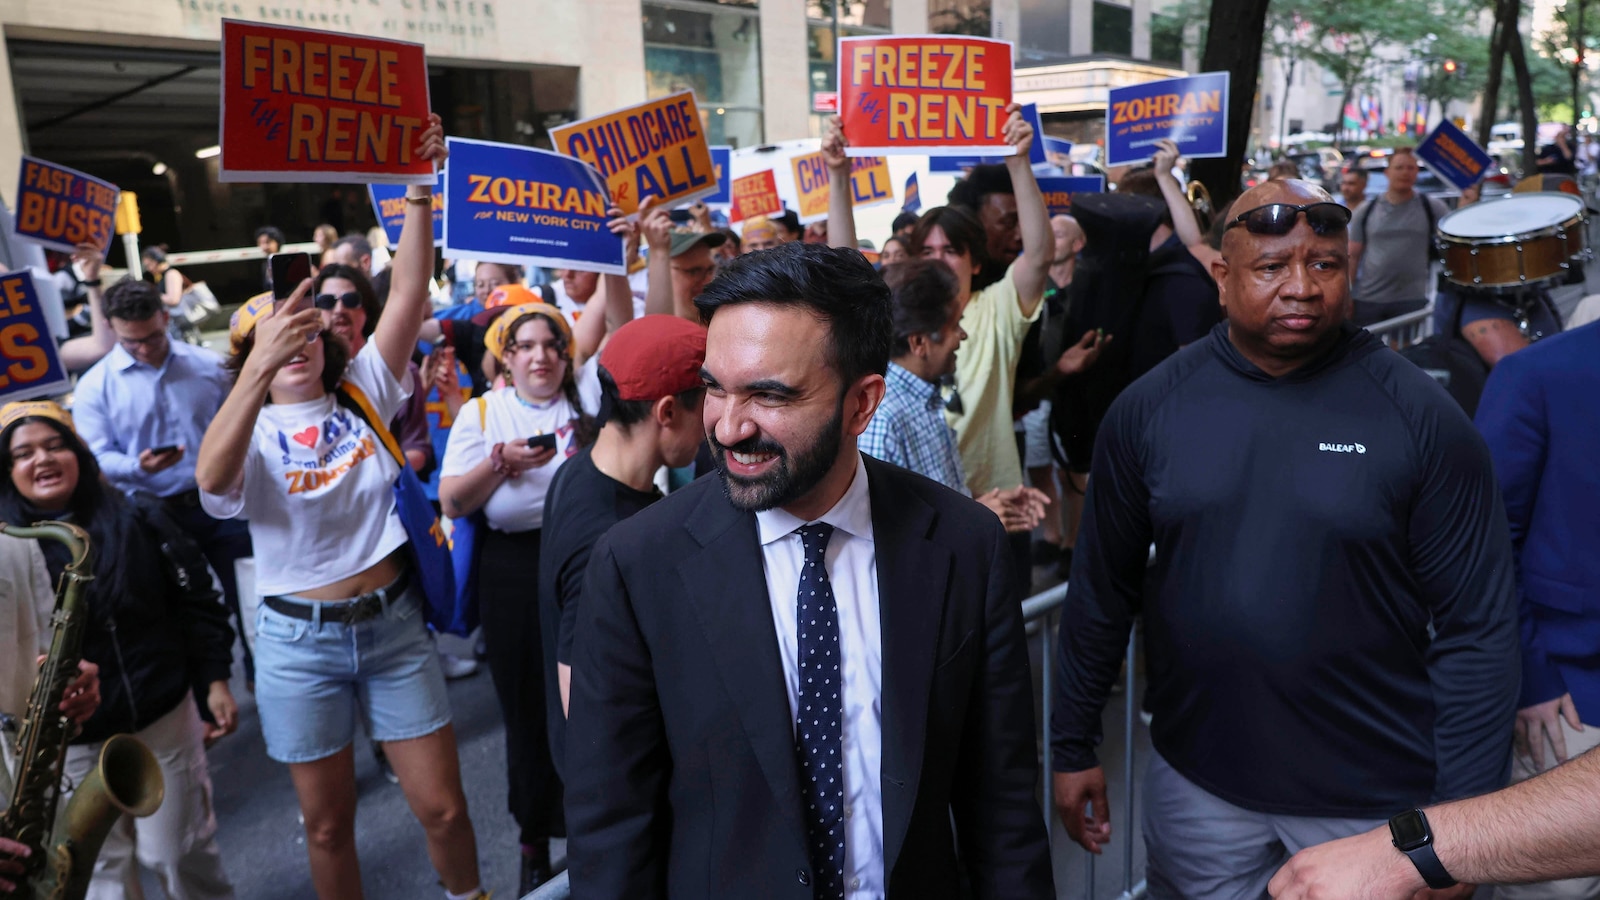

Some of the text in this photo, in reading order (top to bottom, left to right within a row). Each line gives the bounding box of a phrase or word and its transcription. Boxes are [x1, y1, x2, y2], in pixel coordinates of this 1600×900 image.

[242, 35, 402, 109] FREEZE
[852, 45, 986, 92] FREEZE
[250, 98, 285, 141] THE
[858, 92, 884, 124] THE
[888, 92, 1005, 140] RENT
[1112, 90, 1221, 125] ZOHRAN
[287, 102, 421, 165] RENT
[25, 162, 75, 197] FAST
[467, 174, 606, 218] ZOHRAN
[635, 146, 708, 206] ALL
[851, 171, 886, 202] LL
[19, 191, 111, 251] BUSES
[496, 210, 530, 224] NEW
[532, 214, 568, 228] YORK
[571, 217, 601, 232] CITY
[1319, 442, 1355, 453] BALEAF
